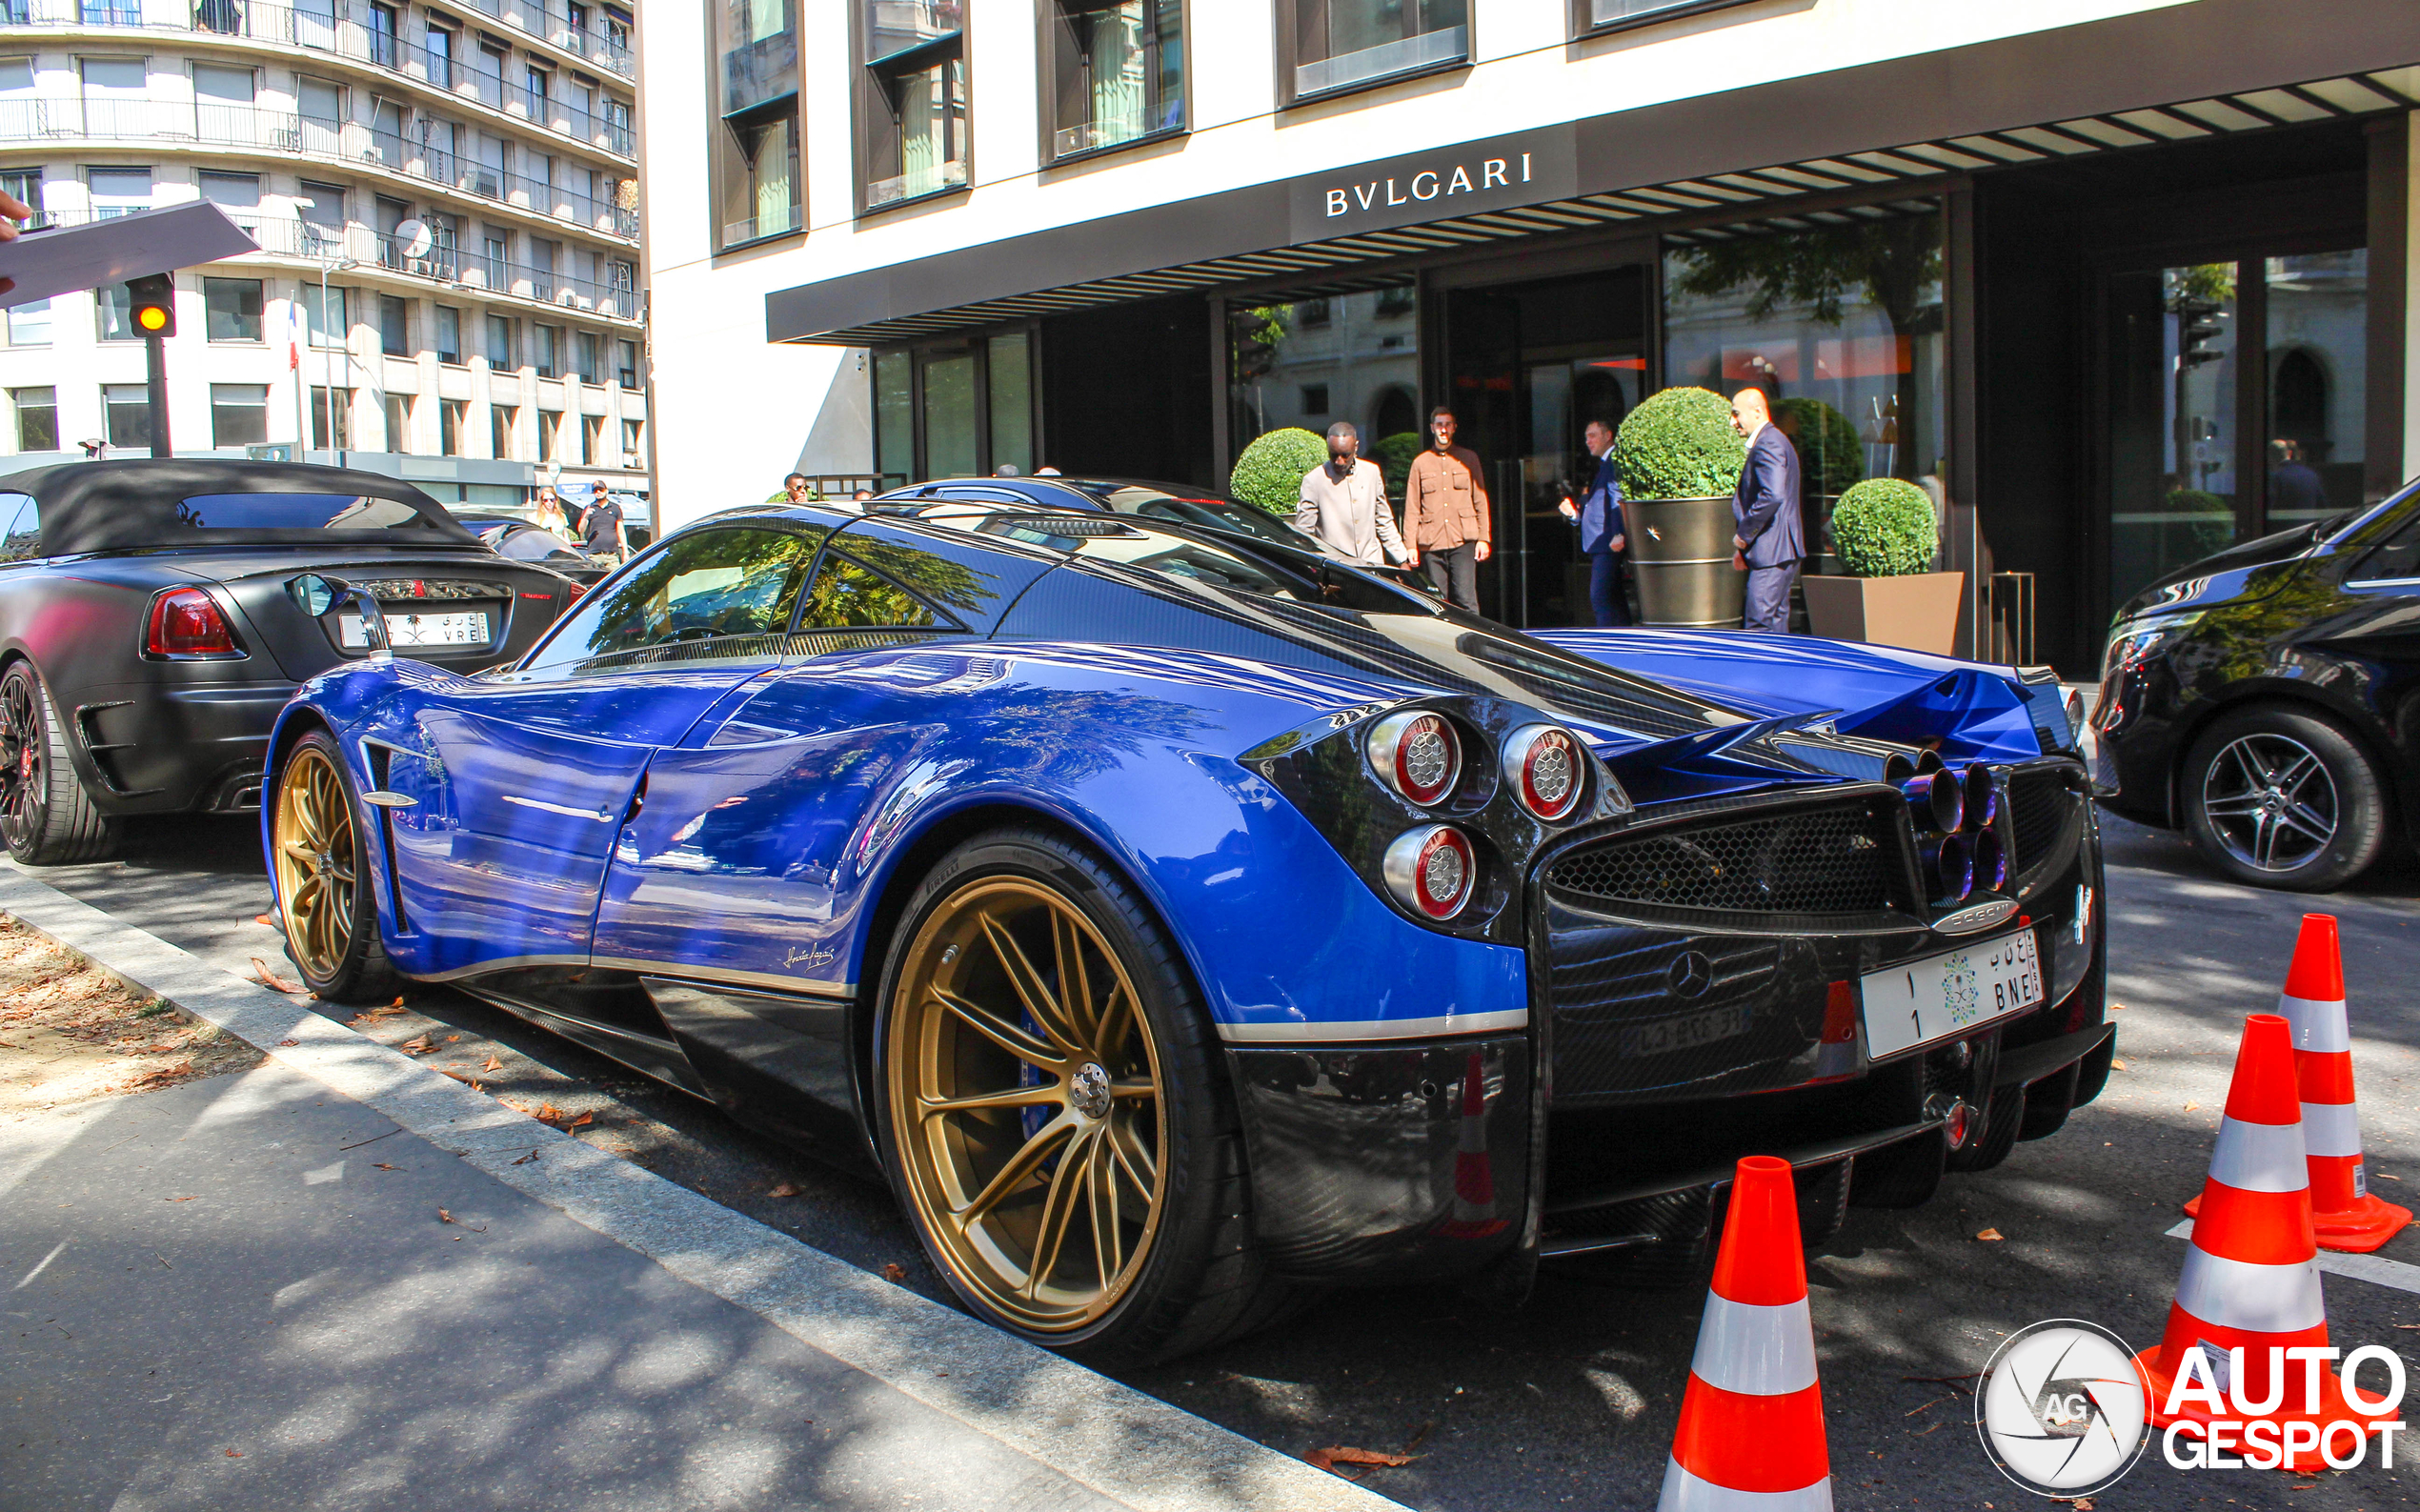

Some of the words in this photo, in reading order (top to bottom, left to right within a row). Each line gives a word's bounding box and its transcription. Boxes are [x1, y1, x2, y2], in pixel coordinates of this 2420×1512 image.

[1325, 152, 1532, 218] BVLGARI
[444, 630, 478, 642] VRE
[1911, 1009, 1922, 1038] 1
[1994, 973, 2032, 1011] BNE
